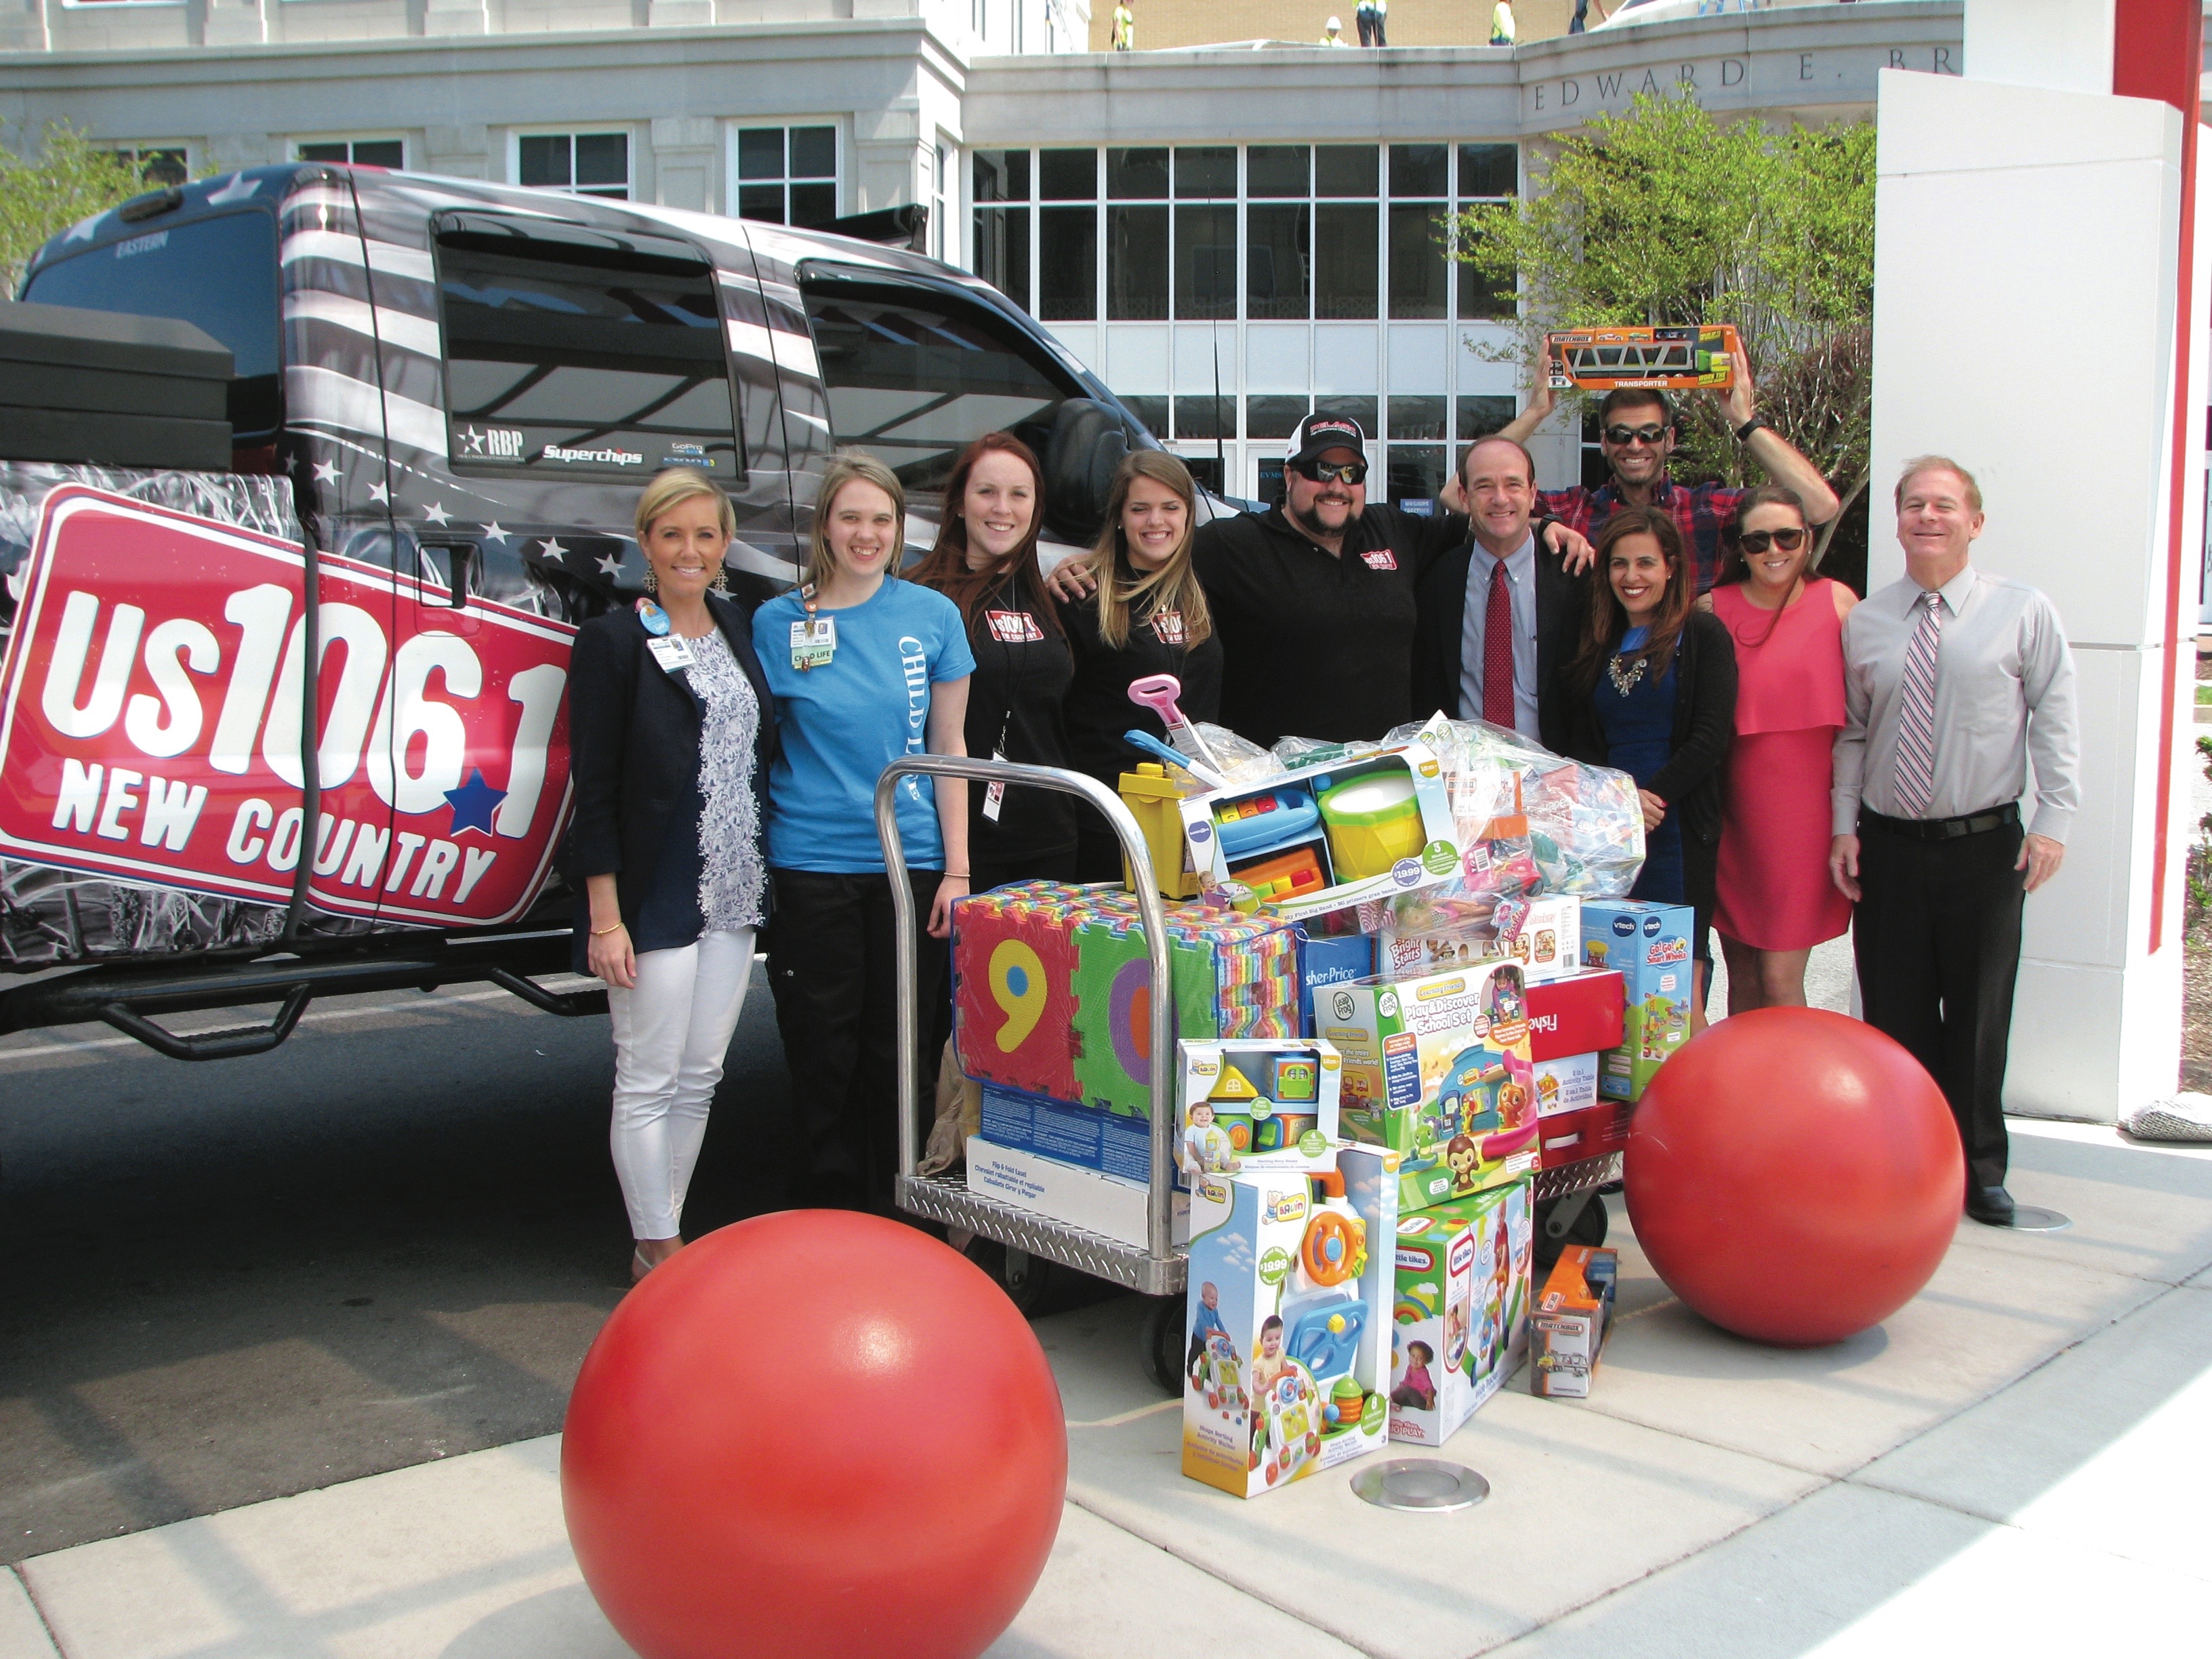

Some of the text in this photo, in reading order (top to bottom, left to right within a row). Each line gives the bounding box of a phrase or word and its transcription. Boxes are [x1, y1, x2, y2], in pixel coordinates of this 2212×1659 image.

[1535, 58, 1745, 110] EDWARD
[116, 230, 169, 258] EASTERN
[486, 429, 525, 456] RBP
[543, 445, 643, 466] Superchips
[794, 653, 815, 662] CHD
[898, 636, 926, 729] CHILD
[52, 758, 497, 905] NEW COUNTRY
[1433, 842, 1441, 853] 3
[1394, 867, 1420, 879] $19.99
[1319, 903, 1333, 912] Band
[1501, 908, 1524, 942] Barbie
[1614, 922, 1635, 930] vtech
[1644, 922, 1660, 930] vtech
[1390, 939, 1421, 959] Bright
[1650, 939, 1675, 955] Go! Go!
[1395, 947, 1421, 969] Starts
[1647, 950, 1687, 964] Smart Wheels
[1419, 981, 1463, 996] Learning Friends
[989, 939, 1048, 1053] 9
[1335, 996, 1349, 1007] Leap
[1380, 994, 1394, 1006] Leap
[1337, 1004, 1352, 1016] Frog
[1382, 1002, 1396, 1015] Frog
[1416, 1015, 1452, 1036] School
[1452, 1009, 1472, 1027] Set
[1563, 1077, 1582, 1086] Activity
[1570, 1093, 1593, 1102] Actividad
[992, 1160, 1000, 1170] Flip
[1005, 1164, 1015, 1174] Fold
[1261, 1259, 1288, 1273] $19.99
[1540, 1322, 1580, 1331] MATCHBOX
[1371, 1395, 1378, 1410] 8
[1197, 1432, 1218, 1444] Activity
[1199, 1425, 1233, 1443] Shape Sorting
